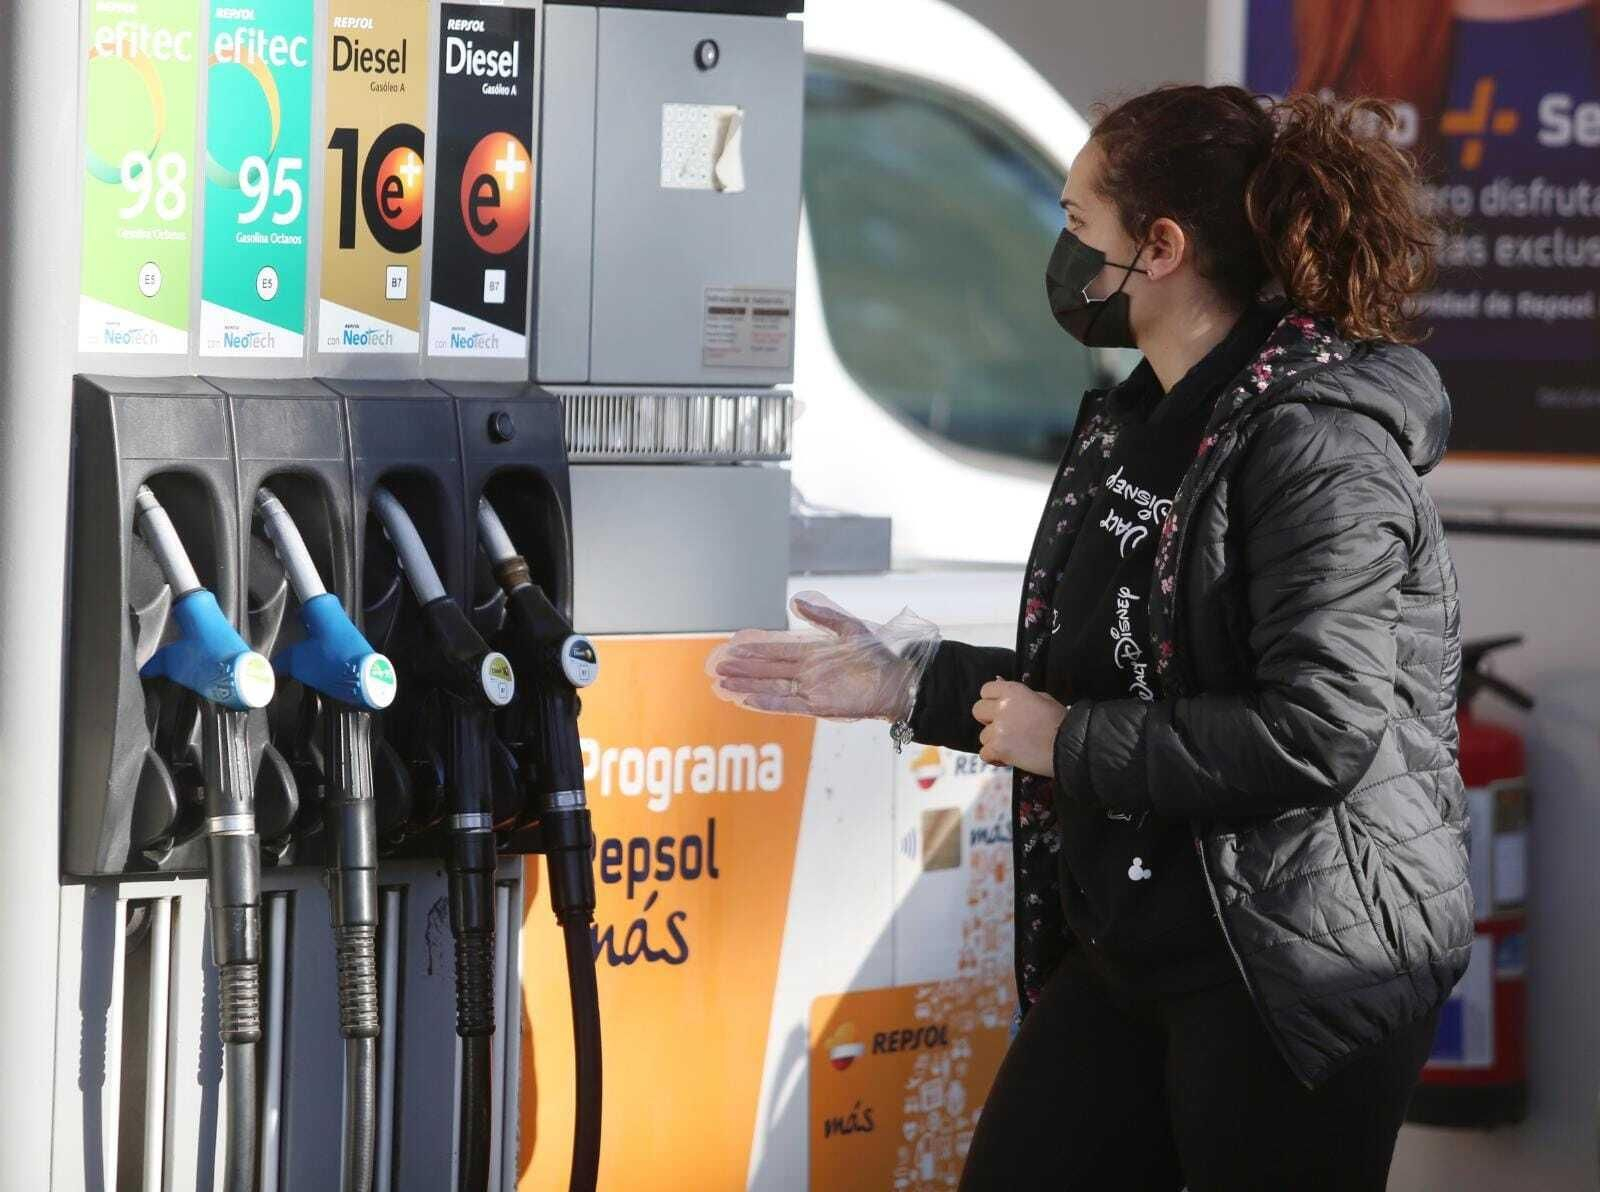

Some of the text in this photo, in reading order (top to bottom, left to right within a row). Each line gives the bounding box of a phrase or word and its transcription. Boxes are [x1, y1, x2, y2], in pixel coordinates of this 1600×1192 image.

[334, 16, 374, 29] REPSOL
[447, 19, 486, 32] REPSOL
[95, 20, 192, 62] efitec
[215, 26, 308, 68] efitec
[332, 35, 407, 74] Diesel
[445, 36, 520, 78] Diesel
[370, 81, 406, 93] Gasóleo A
[511, 86, 517, 96] A
[1536, 93, 1600, 147] Se
[118, 149, 188, 221] 98
[236, 155, 304, 226] 95
[236, 232, 302, 245] Gasolina Octanos
[144, 274, 156, 285] E5
[262, 278, 273, 288] E5
[391, 277, 402, 288] B7
[224, 331, 275, 349] NeoTech
[343, 328, 393, 346] NeoTech
[450, 332, 499, 349] NeoTech
[580, 737, 783, 813] Programa
[592, 817, 719, 900] epsol
[872, 1024, 949, 1055] REPSOL
[823, 1100, 876, 1139] más
